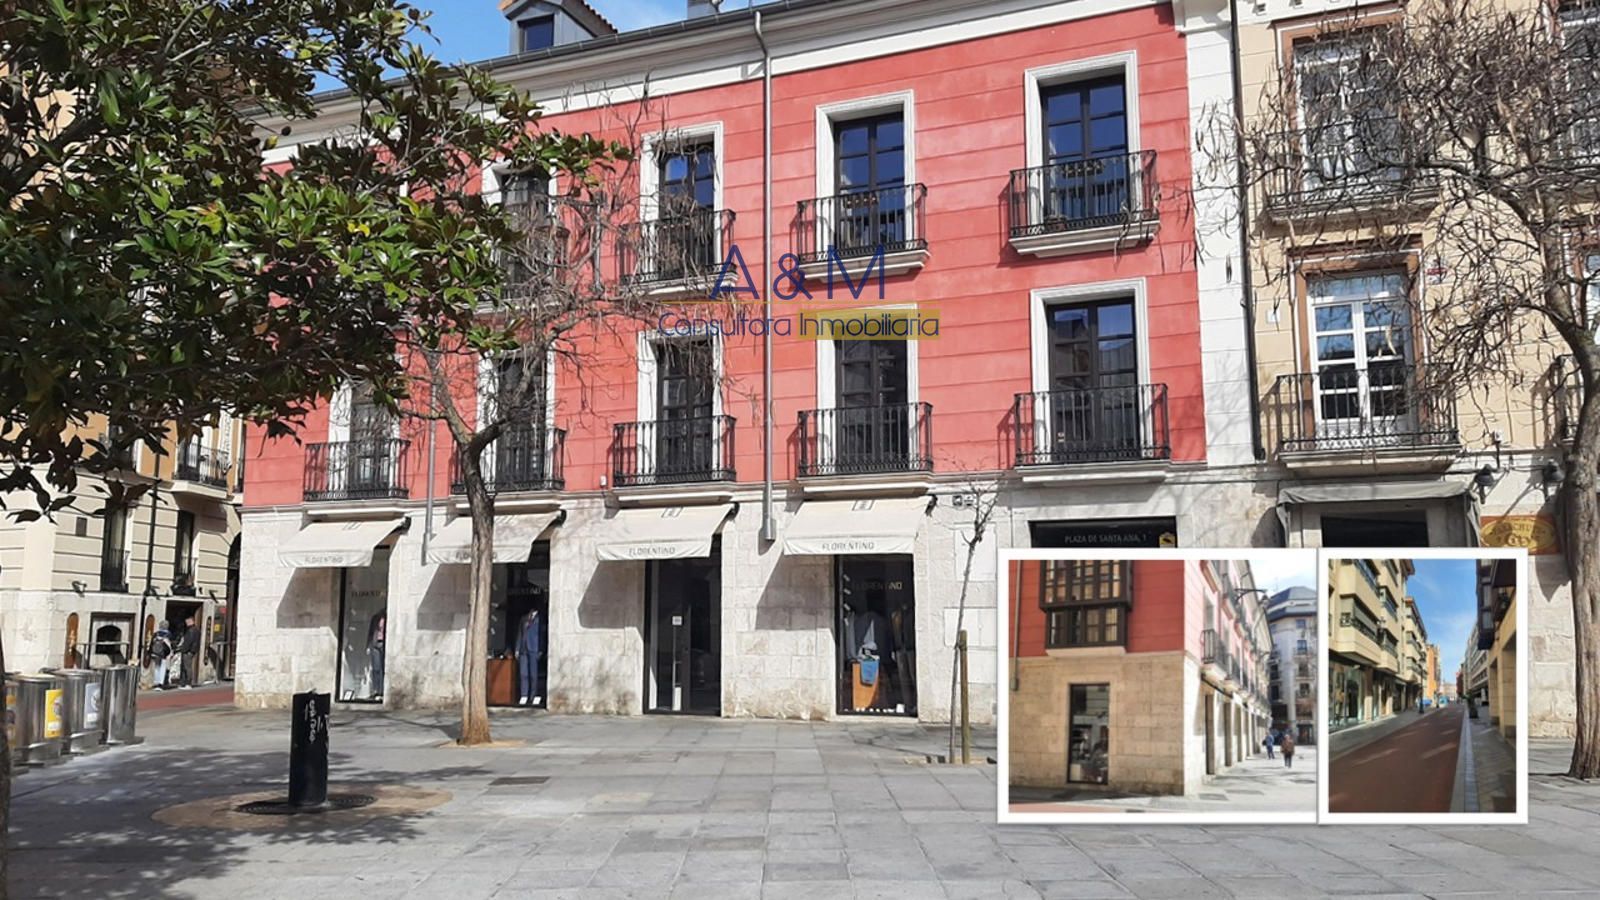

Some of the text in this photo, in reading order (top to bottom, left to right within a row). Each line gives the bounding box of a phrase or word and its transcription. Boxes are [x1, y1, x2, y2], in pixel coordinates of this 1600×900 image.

[1064, 535, 1087, 544] PLAZA
[1100, 534, 1122, 543] SANTA
[628, 546, 676, 556] FLORENTINO
[822, 542, 875, 551] FLORENTINO
